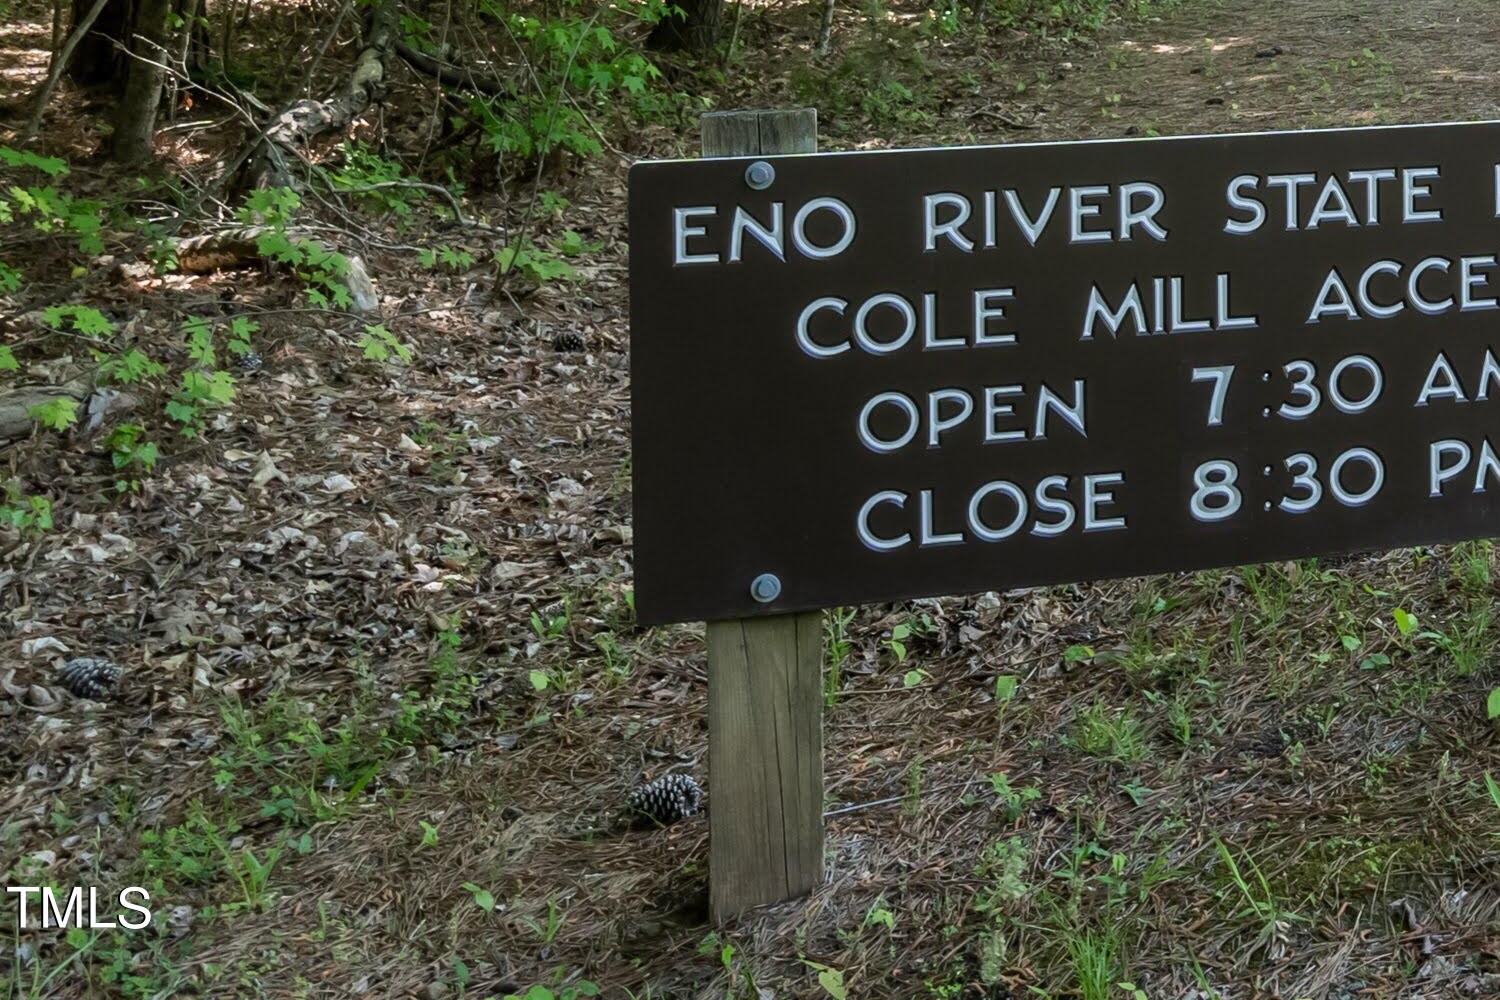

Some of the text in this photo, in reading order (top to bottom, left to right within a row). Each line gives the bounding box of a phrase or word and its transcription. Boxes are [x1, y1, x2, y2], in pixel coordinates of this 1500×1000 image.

[673, 196, 857, 267] ENO
[923, 182, 1169, 253] RIVER
[1222, 166, 1442, 235] STATE
[796, 287, 1017, 360] COLE
[1080, 273, 1259, 342] MILL
[857, 378, 1087, 454] OPEN
[856, 471, 1128, 553] CLOSE
